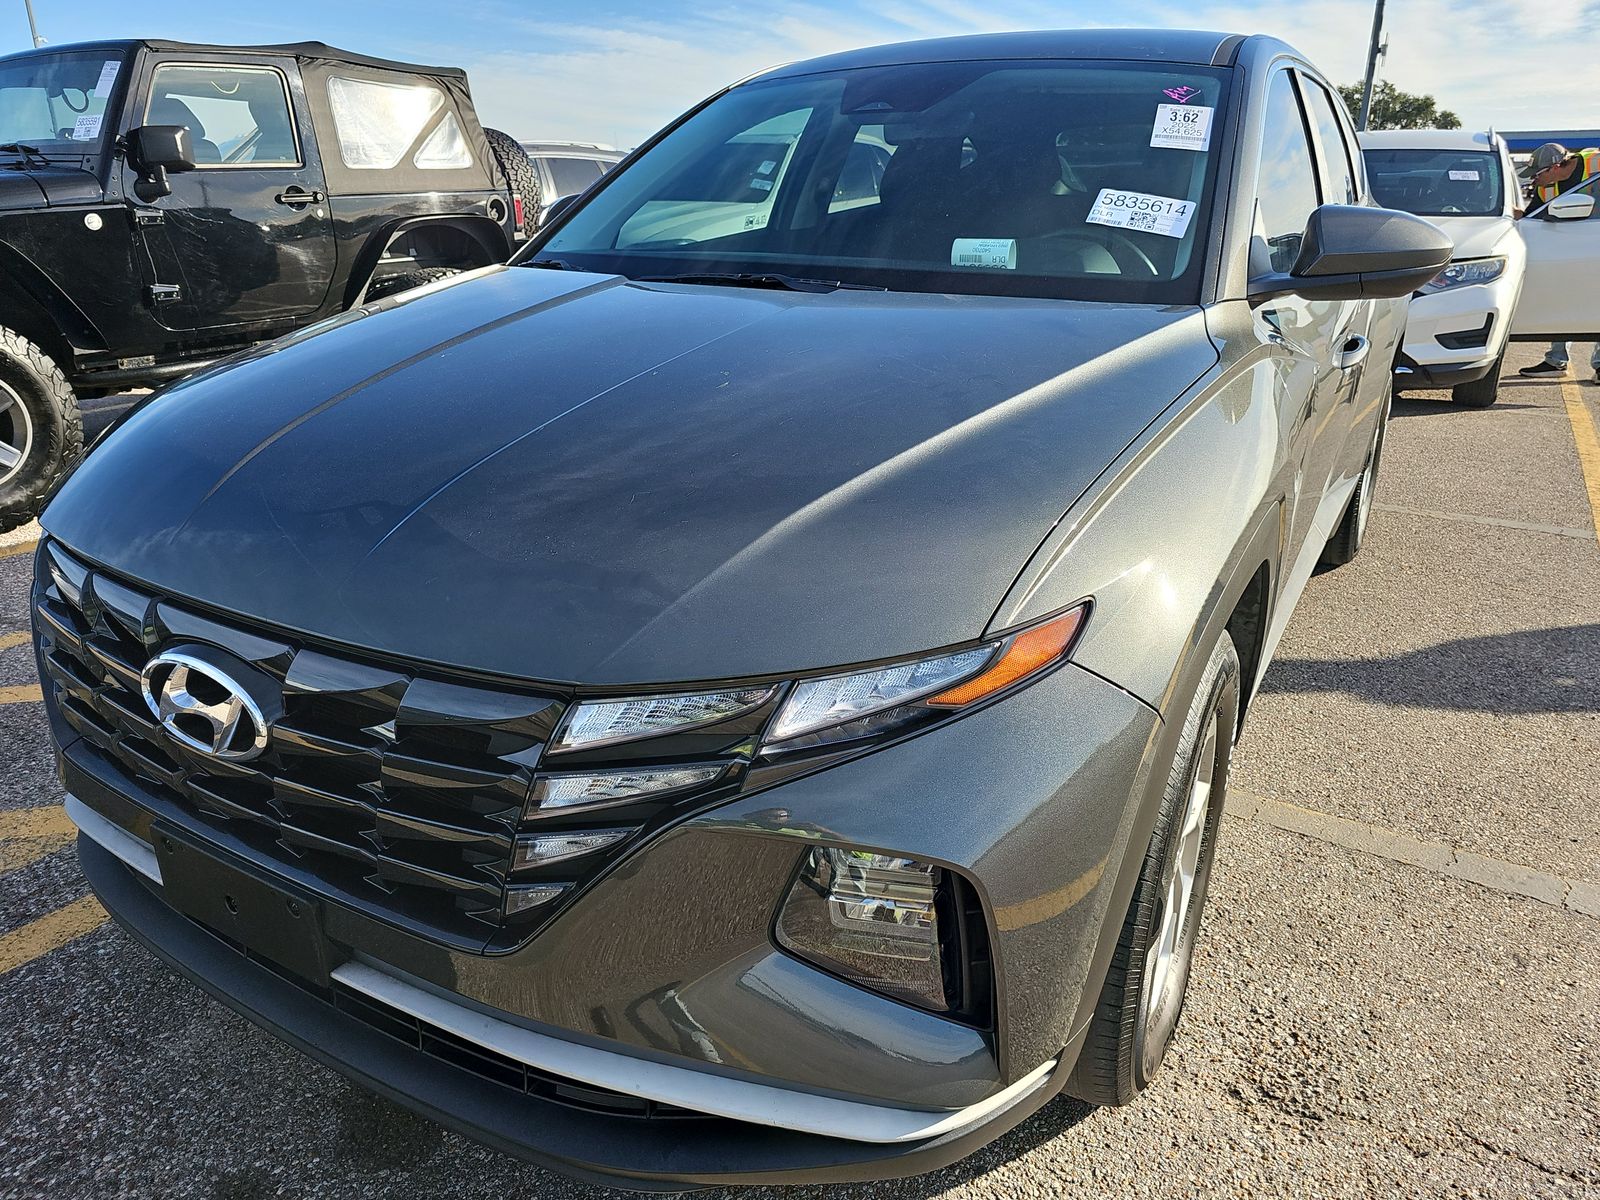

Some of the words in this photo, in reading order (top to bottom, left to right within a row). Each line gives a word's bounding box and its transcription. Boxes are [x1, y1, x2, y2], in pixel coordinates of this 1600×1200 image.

[1169, 111, 1199, 123] 3:62
[1172, 121, 1196, 130] 2022
[1101, 192, 1188, 217] 5835614
[1092, 208, 1114, 218] DLR
[991, 255, 1006, 263] DLR
